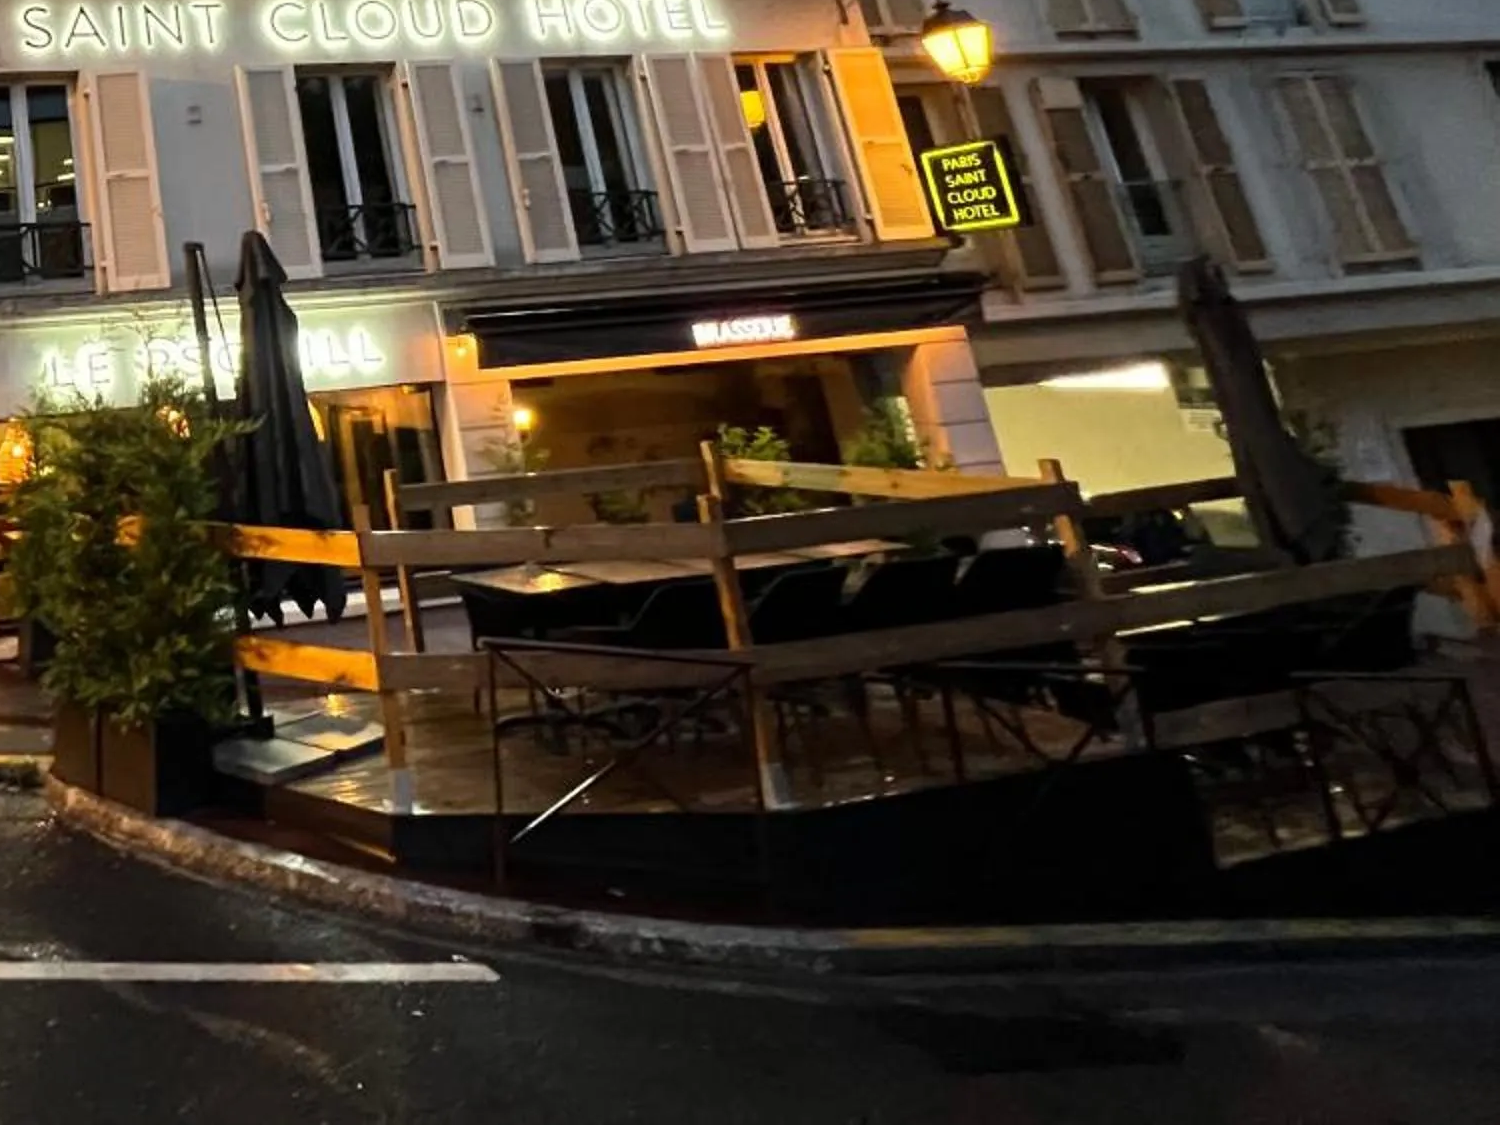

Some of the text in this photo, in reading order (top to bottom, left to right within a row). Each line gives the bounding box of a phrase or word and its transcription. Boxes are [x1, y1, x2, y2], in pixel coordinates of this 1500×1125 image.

[23, 3, 221, 49] SAINT
[941, 152, 982, 172] PARIS
[945, 169, 987, 188] SAINT
[947, 185, 998, 204] CLOUD
[953, 204, 1001, 221] HOTEL
[49, 350, 112, 388] LE
